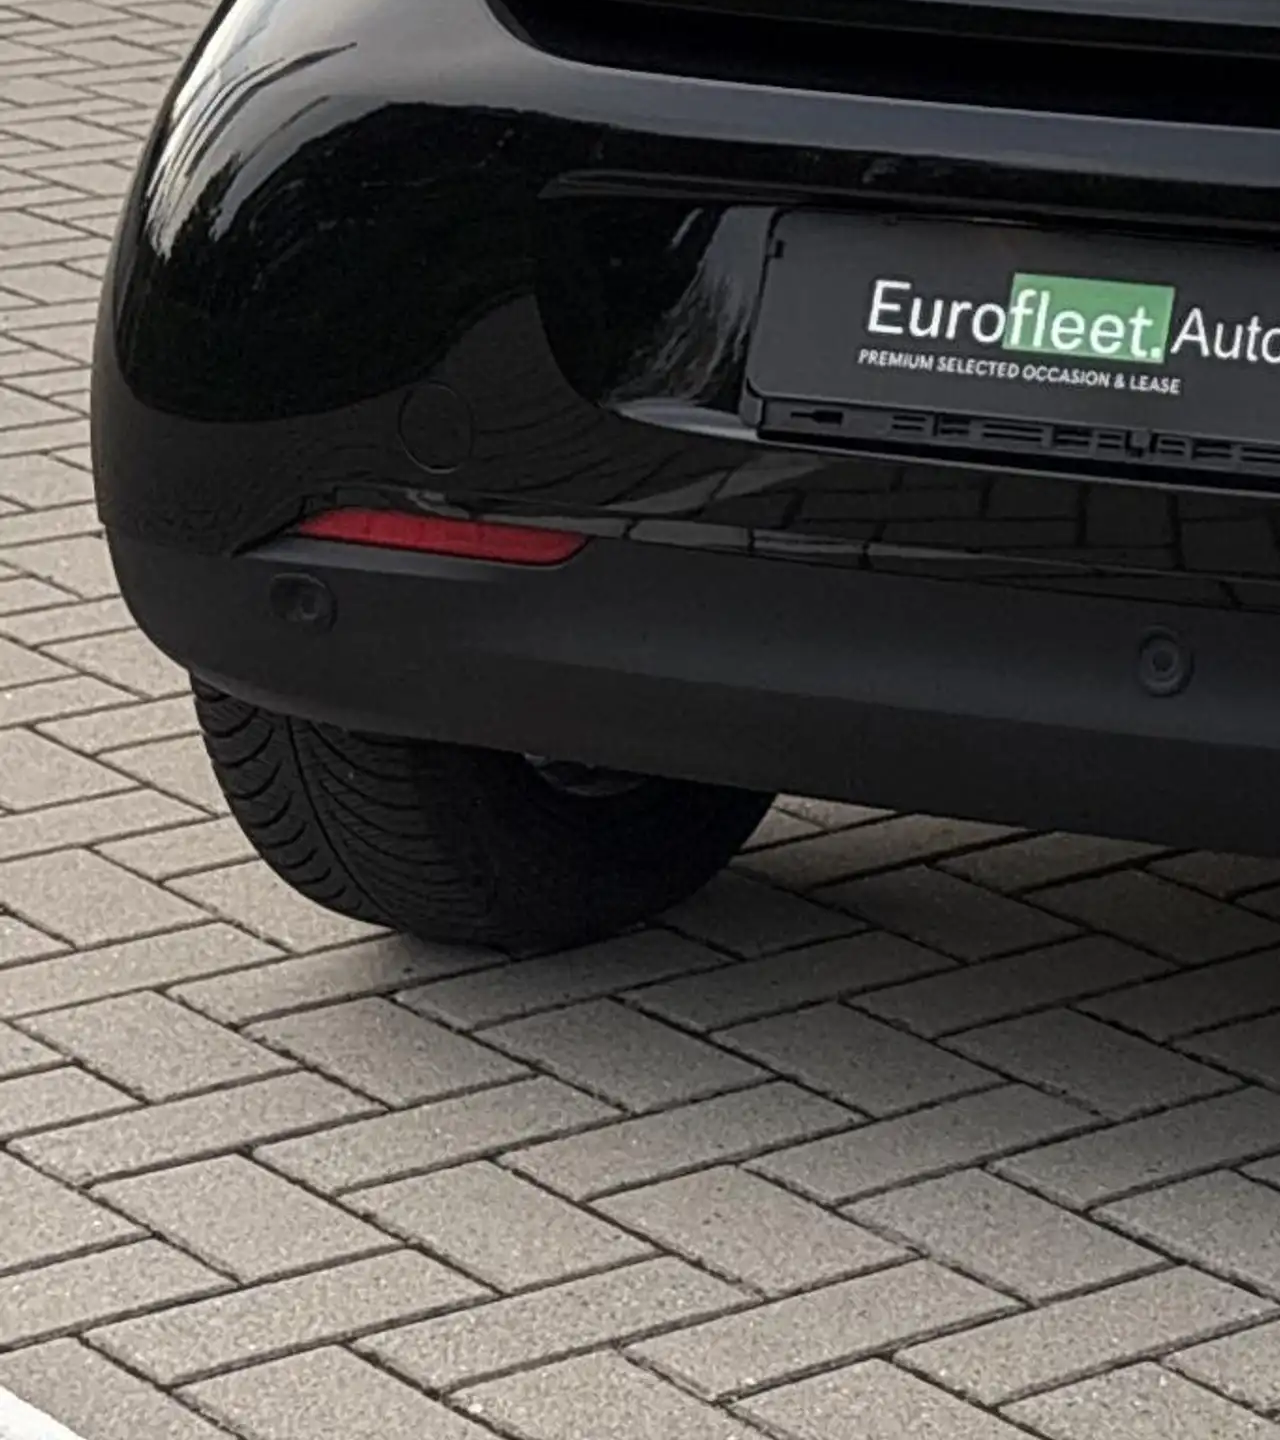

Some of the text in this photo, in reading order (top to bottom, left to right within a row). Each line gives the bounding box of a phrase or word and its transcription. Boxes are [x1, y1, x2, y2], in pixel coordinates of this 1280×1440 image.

[867, 278, 1162, 360] Eurofleet.
[858, 348, 1182, 395] PREMIUM SELECTED OCCASION & LEASE
